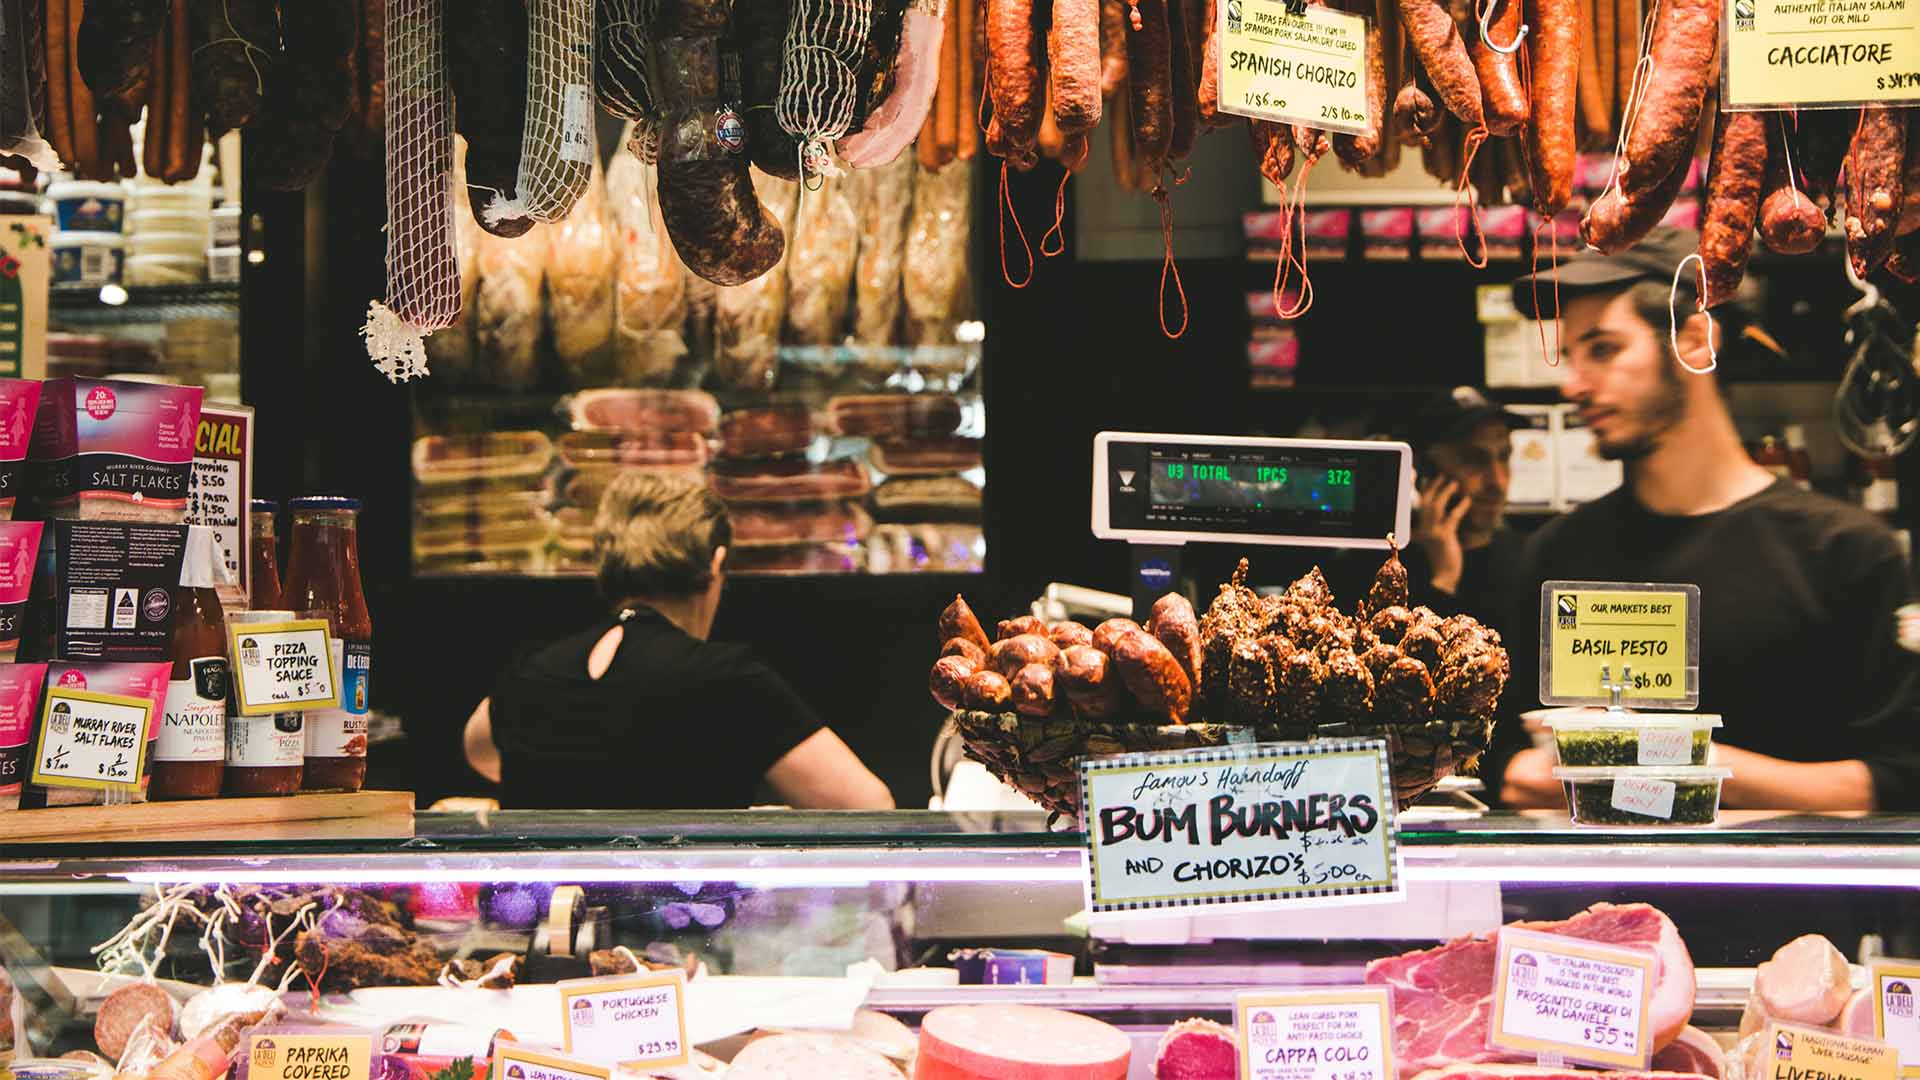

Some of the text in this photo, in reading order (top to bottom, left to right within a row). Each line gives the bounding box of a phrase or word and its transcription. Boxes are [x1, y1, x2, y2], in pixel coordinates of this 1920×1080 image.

[1774, 0, 1905, 14] AUTHENTIC ITALIAN SALAMI
[1255, 12, 1277, 25] TAPAS
[1278, 16, 1313, 32] FAVOURITE
[1809, 14, 1870, 25] HOT OR MILD
[1244, 22, 1273, 36] SPANISH
[1768, 43, 1892, 67] CACCIATORE
[1230, 50, 1356, 88] SPANISH CHORIZO
[92, 471, 180, 490] SALT FLAKES
[1192, 464, 1231, 481] TOTAL
[1256, 466, 1288, 483] 1PCS
[1591, 603, 1672, 614] OUR MARKETS BEST
[274, 643, 307, 656] PIZZA
[1572, 639, 1668, 656] BASIL PESTO
[266, 656, 318, 670] TOPPING
[276, 668, 313, 682] SAUCE
[1634, 672, 1672, 689] $6.00
[73, 716, 137, 736] MURRAY RIVER
[74, 731, 134, 749] SALT FLAKES
[1101, 803, 1200, 846] BUM
[1208, 793, 1379, 847] BURNERS
[1125, 858, 1164, 875] AND
[602, 993, 668, 1009] PORTUGUESE
[1517, 989, 1632, 1018] PROSCIUTTO CRUDI DI
[614, 1007, 659, 1021] CHICKEN
[1536, 1004, 1609, 1026] SAN DANIELE
[286, 1047, 349, 1065] PAPRIKA
[1265, 1046, 1369, 1064] CAPPA COLO
[283, 1064, 352, 1080] COVERED
